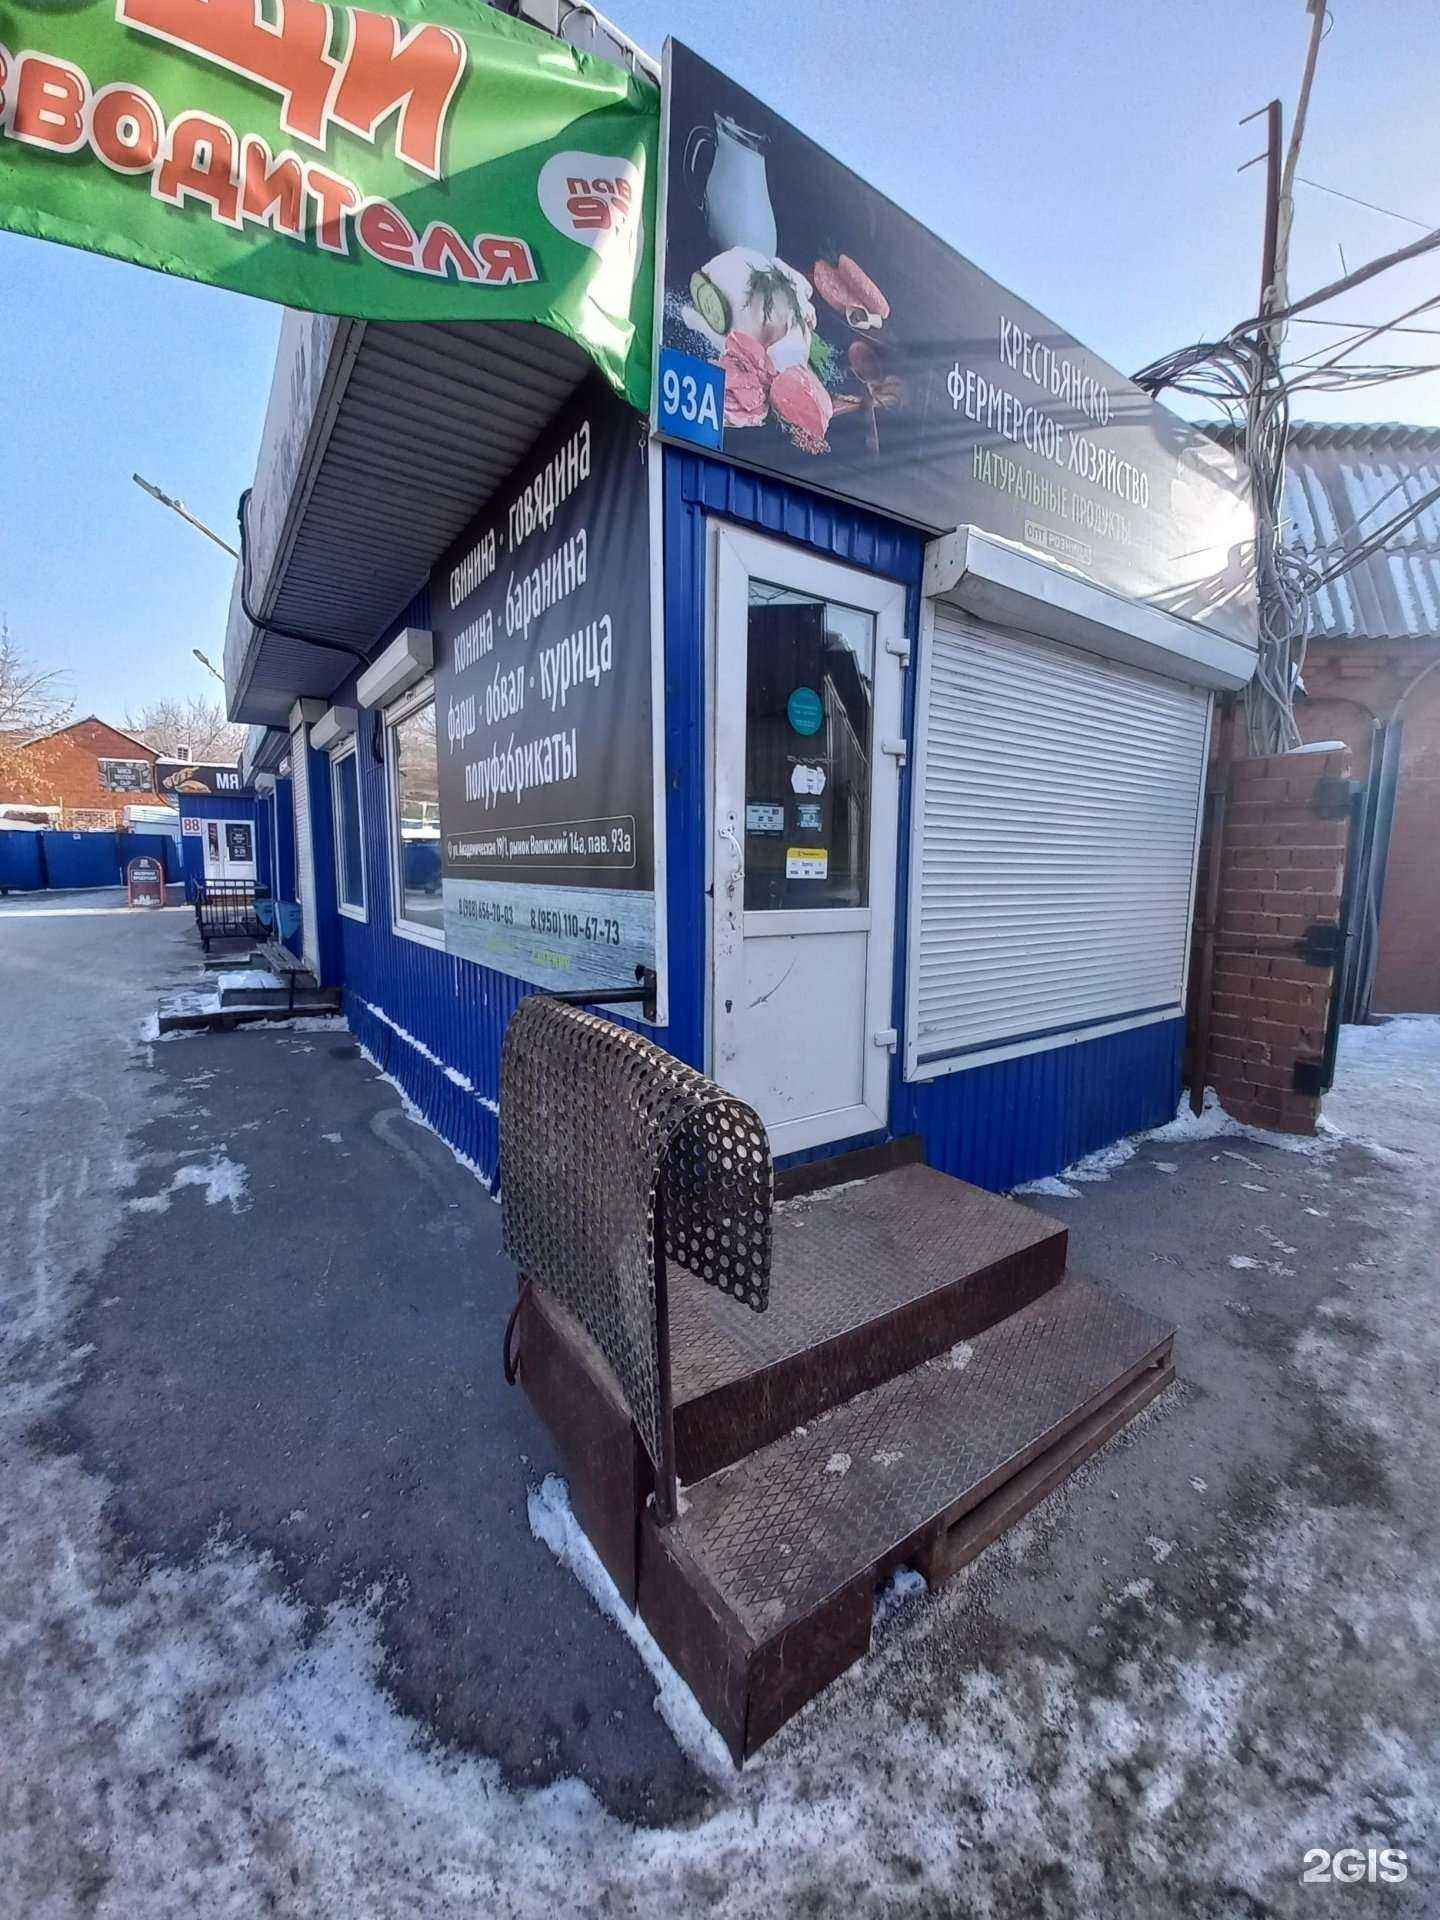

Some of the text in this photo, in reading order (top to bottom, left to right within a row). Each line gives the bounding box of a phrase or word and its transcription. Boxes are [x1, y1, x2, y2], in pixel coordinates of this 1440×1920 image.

[0, 42, 540, 285] водителя
[663, 369, 719, 432] 93А
[999, 316, 1114, 426] КРЕСТЬЯНСКО-
[947, 362, 1149, 509] ФЕРМЕРСКОЕ ХОЗЯЙСТВО
[973, 444, 1068, 519] НАТУРАЛЬНЫЕ
[450, 420, 590, 610] свинина говядина
[453, 528, 587, 675] конина баранина
[447, 614, 612, 755] фарш обвал курица
[465, 727, 577, 811] полуфабрикаты
[184, 819, 200, 832] 88
[530, 831, 568, 856] Волжский
[611, 828, 631, 853] 93а
[530, 908, 620, 946] 8 (950) 110-67-73
